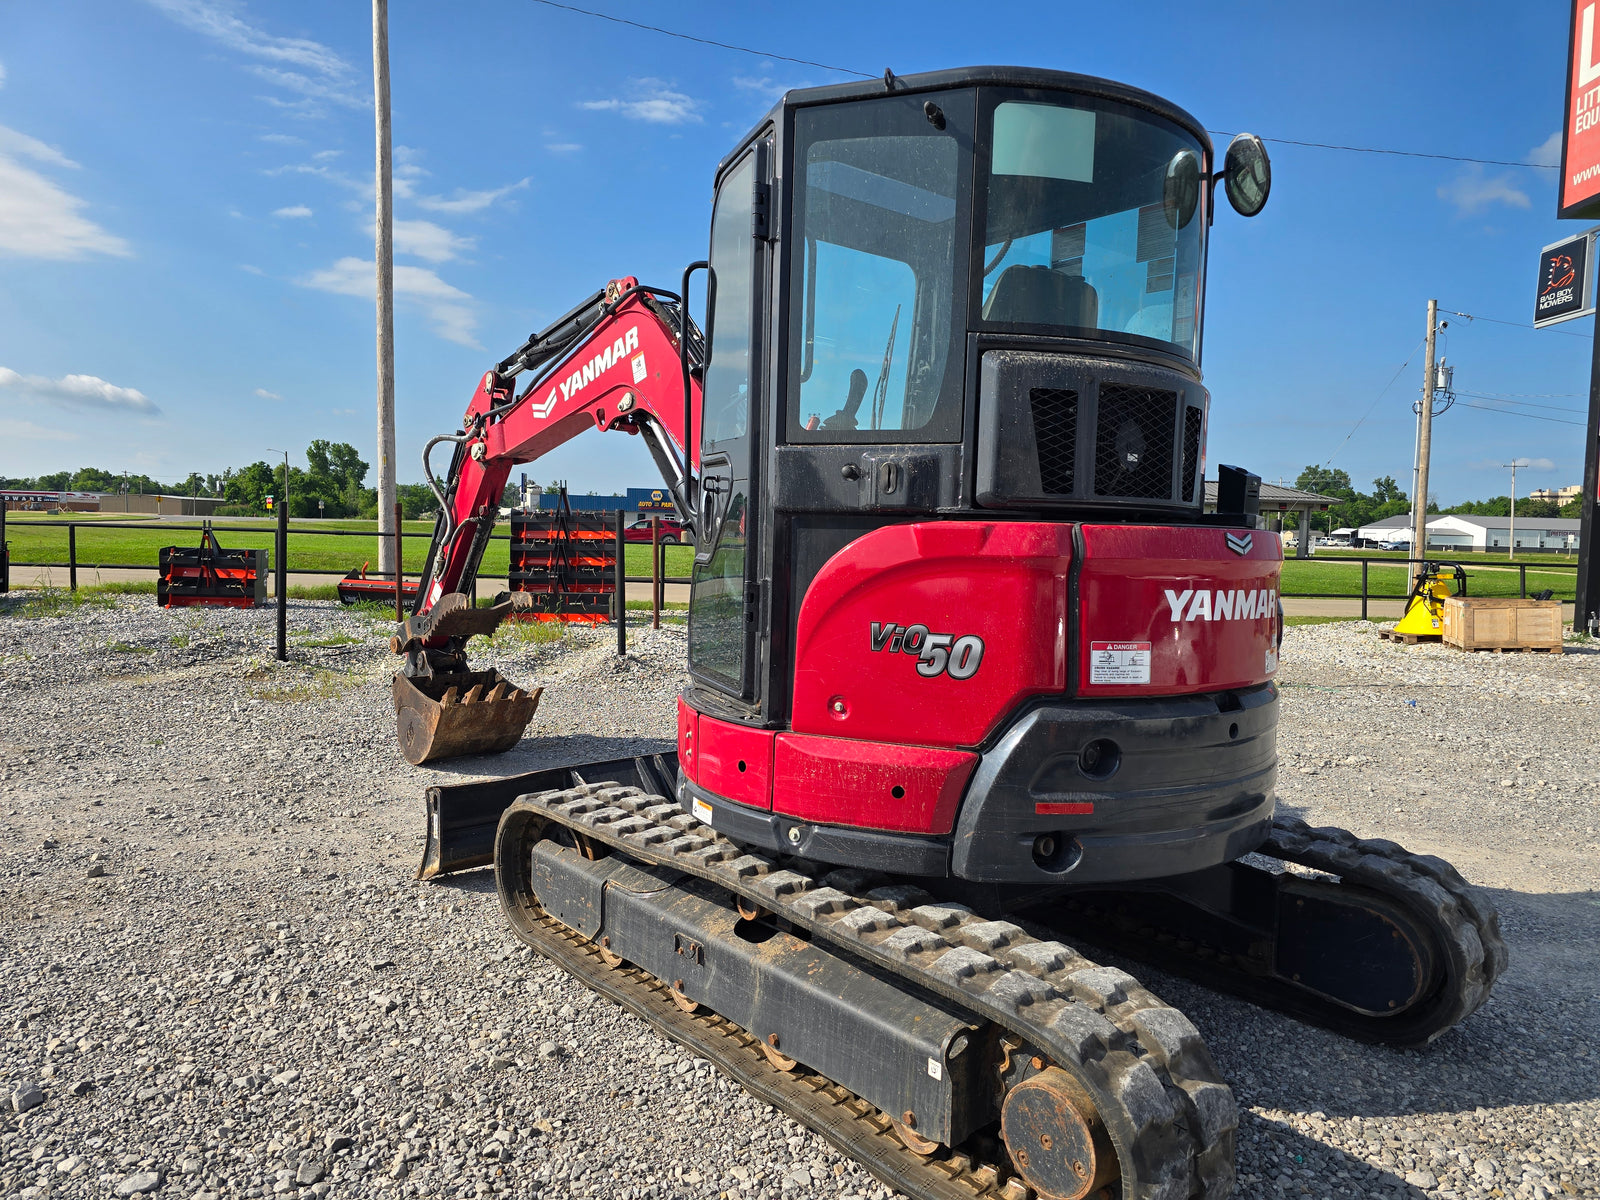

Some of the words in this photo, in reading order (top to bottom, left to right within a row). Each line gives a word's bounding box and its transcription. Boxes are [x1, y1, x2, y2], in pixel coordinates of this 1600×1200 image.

[1538, 293, 1574, 311] MOWERS
[1539, 292, 1556, 304] BAD
[1556, 286, 1574, 299] BOY
[559, 325, 639, 402] YANMAR
[1164, 589, 1276, 622] YANMAR
